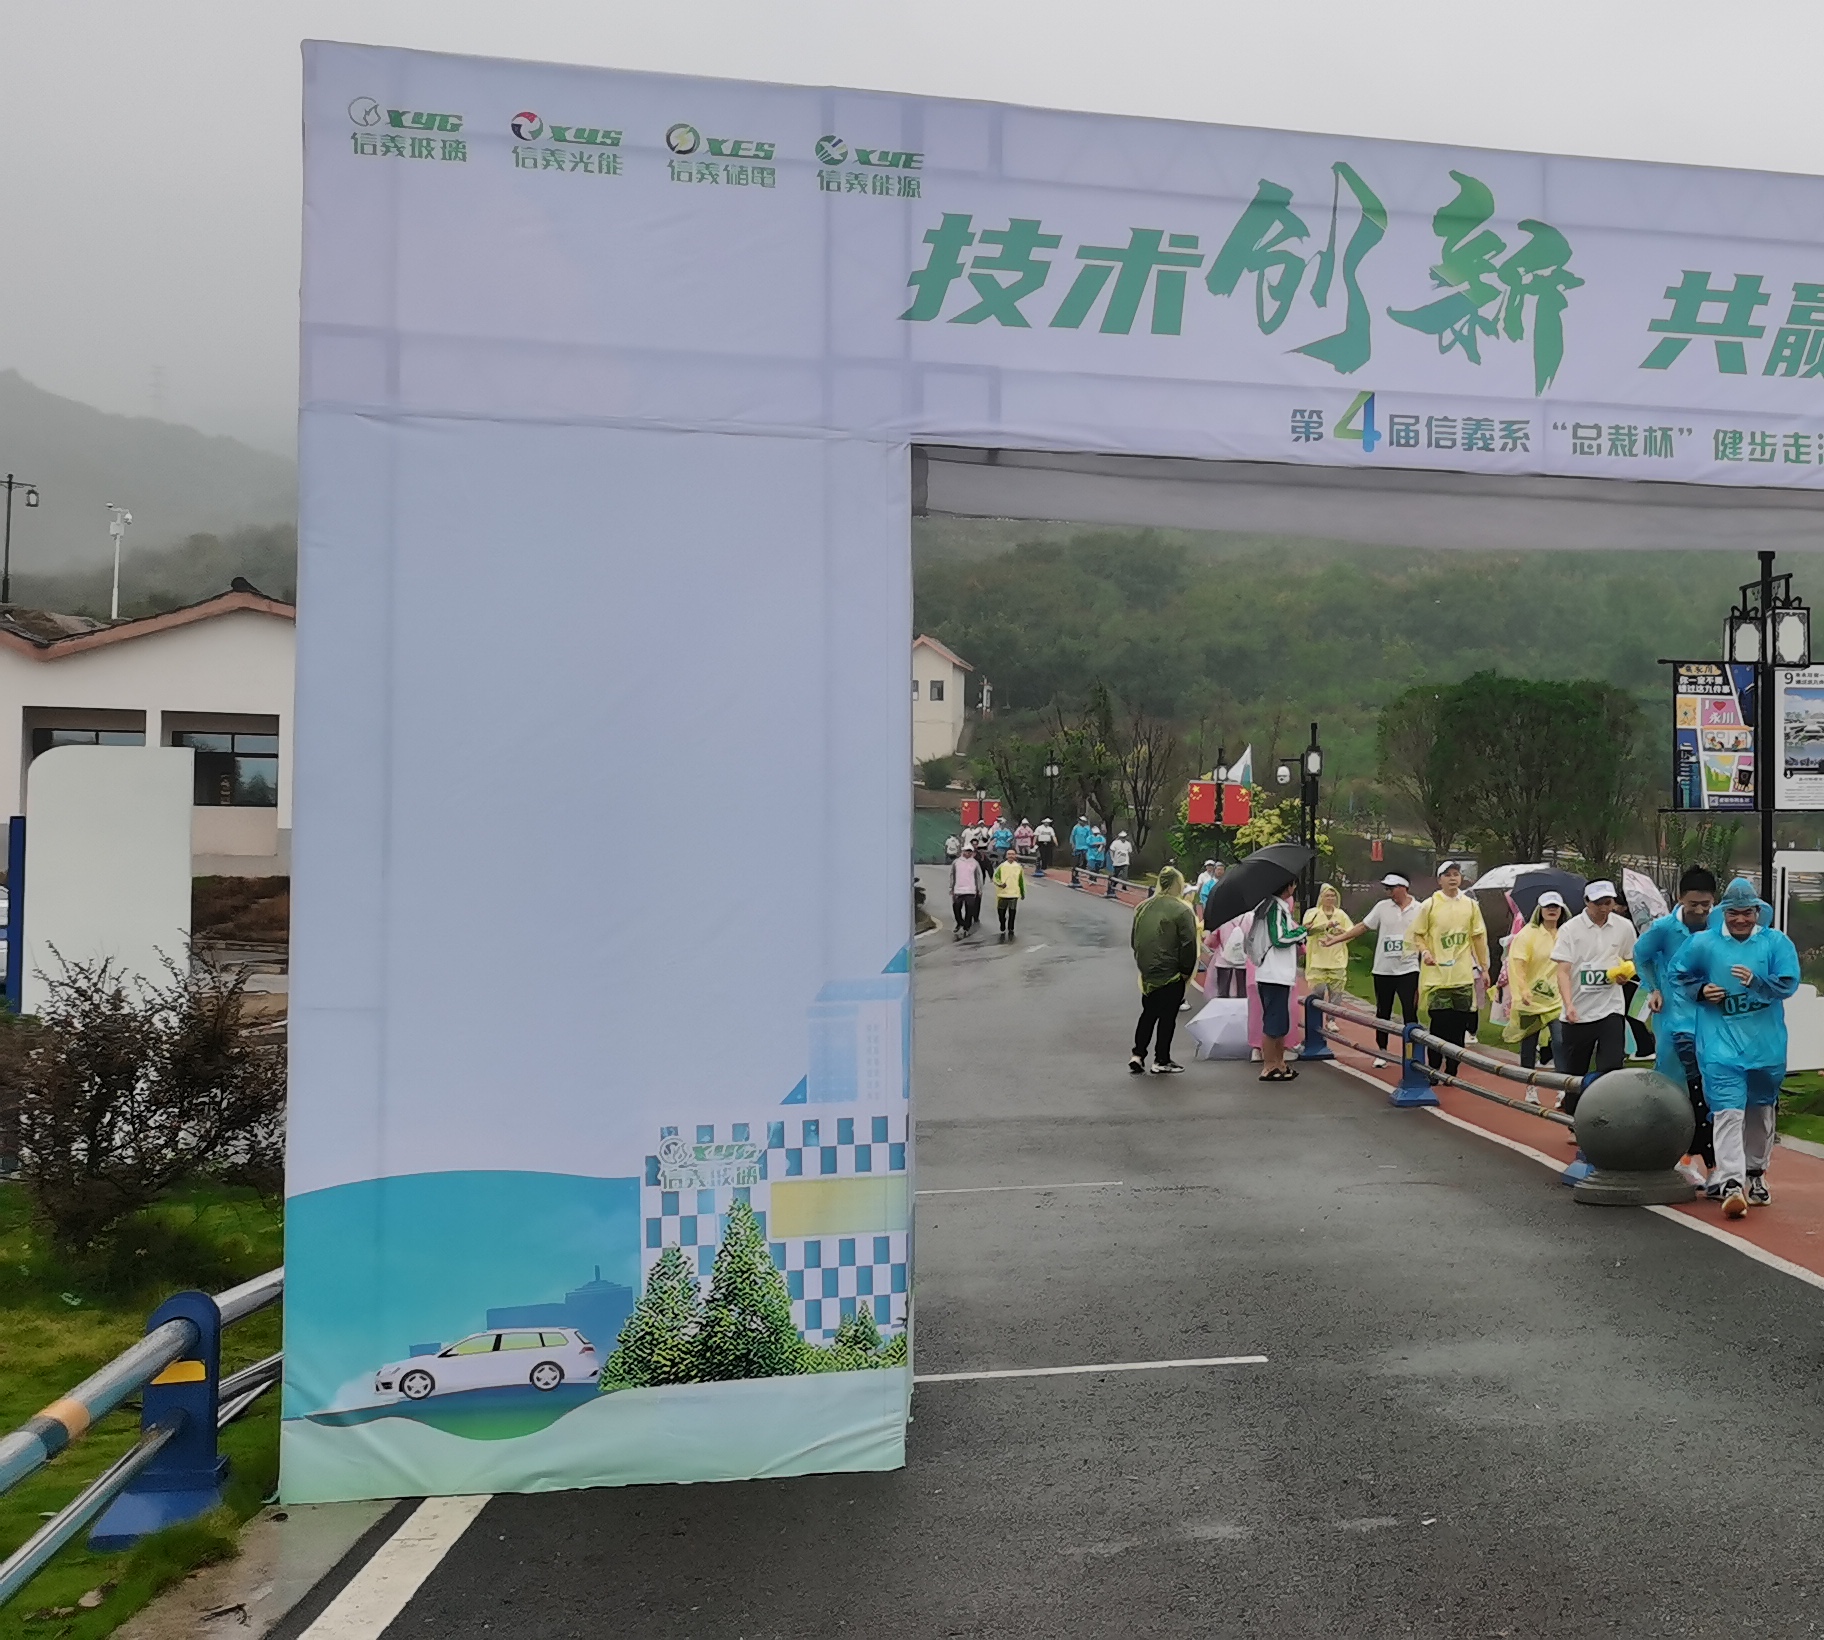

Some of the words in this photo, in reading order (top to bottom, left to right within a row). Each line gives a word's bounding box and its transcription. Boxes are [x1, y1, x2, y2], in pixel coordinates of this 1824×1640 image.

[386, 109, 463, 133] XYG
[548, 124, 624, 147] XYS
[896, 161, 1586, 398] 技术创新
[1290, 390, 1532, 453] 第4届信義系
